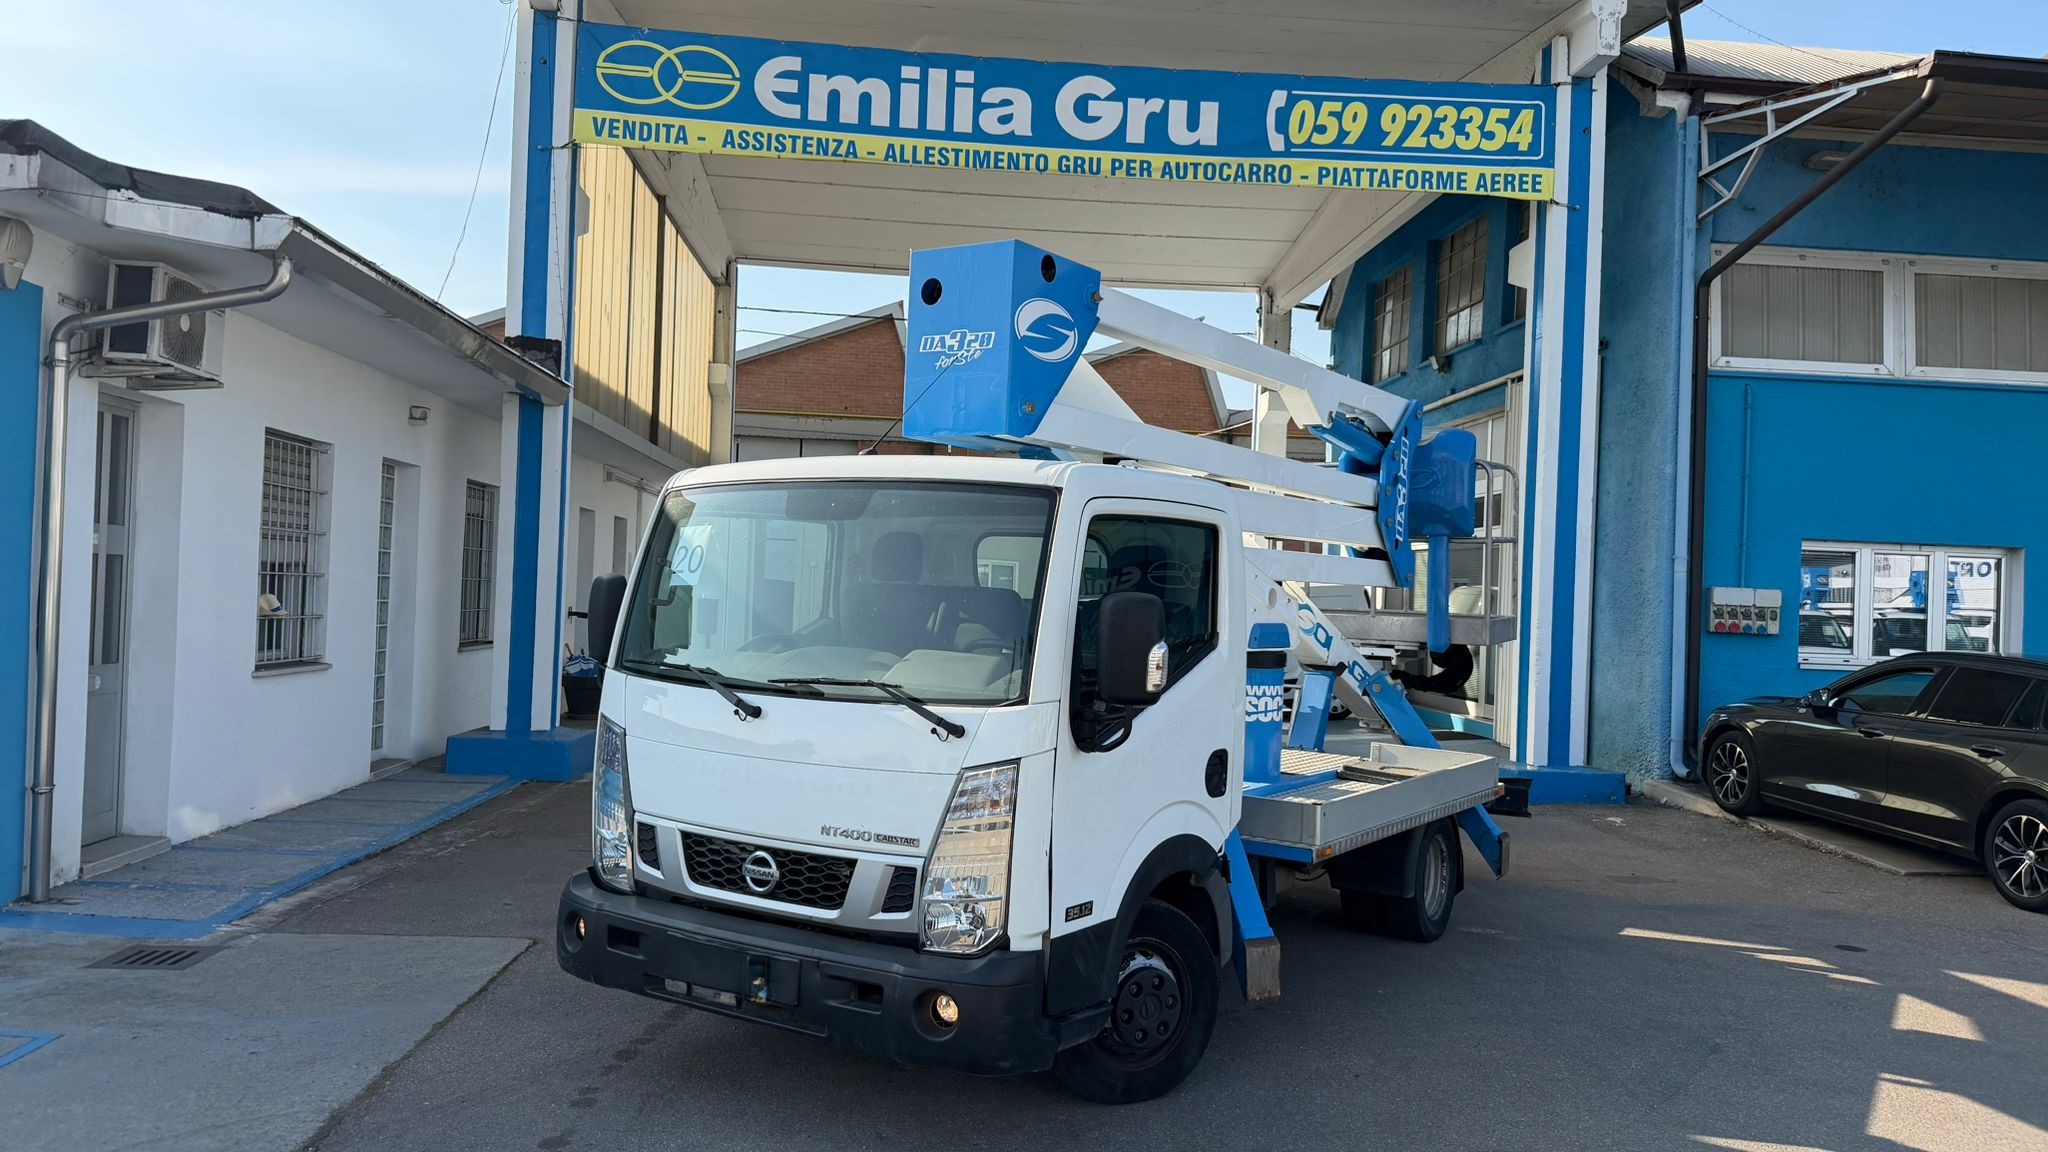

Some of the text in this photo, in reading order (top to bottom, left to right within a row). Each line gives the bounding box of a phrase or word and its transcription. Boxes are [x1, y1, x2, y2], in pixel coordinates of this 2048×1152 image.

[754, 56, 1220, 146] Emilia Gru
[1288, 100, 1534, 151] 059 923354
[592, 116, 689, 145] VENDITA
[721, 129, 858, 159] ASSISTENZA
[884, 143, 1049, 173] ALLESTIMENTO
[1057, 154, 1102, 176] GRU
[1110, 157, 1153, 178] PER
[1160, 160, 1292, 184] AUTOCARRO
[1317, 166, 1468, 191] PIATTAFORME
[1475, 172, 1543, 194] AEREE
[820, 824, 872, 842] NT400
[743, 866, 776, 879] NISSAN
[1066, 902, 1092, 921] 35.12
